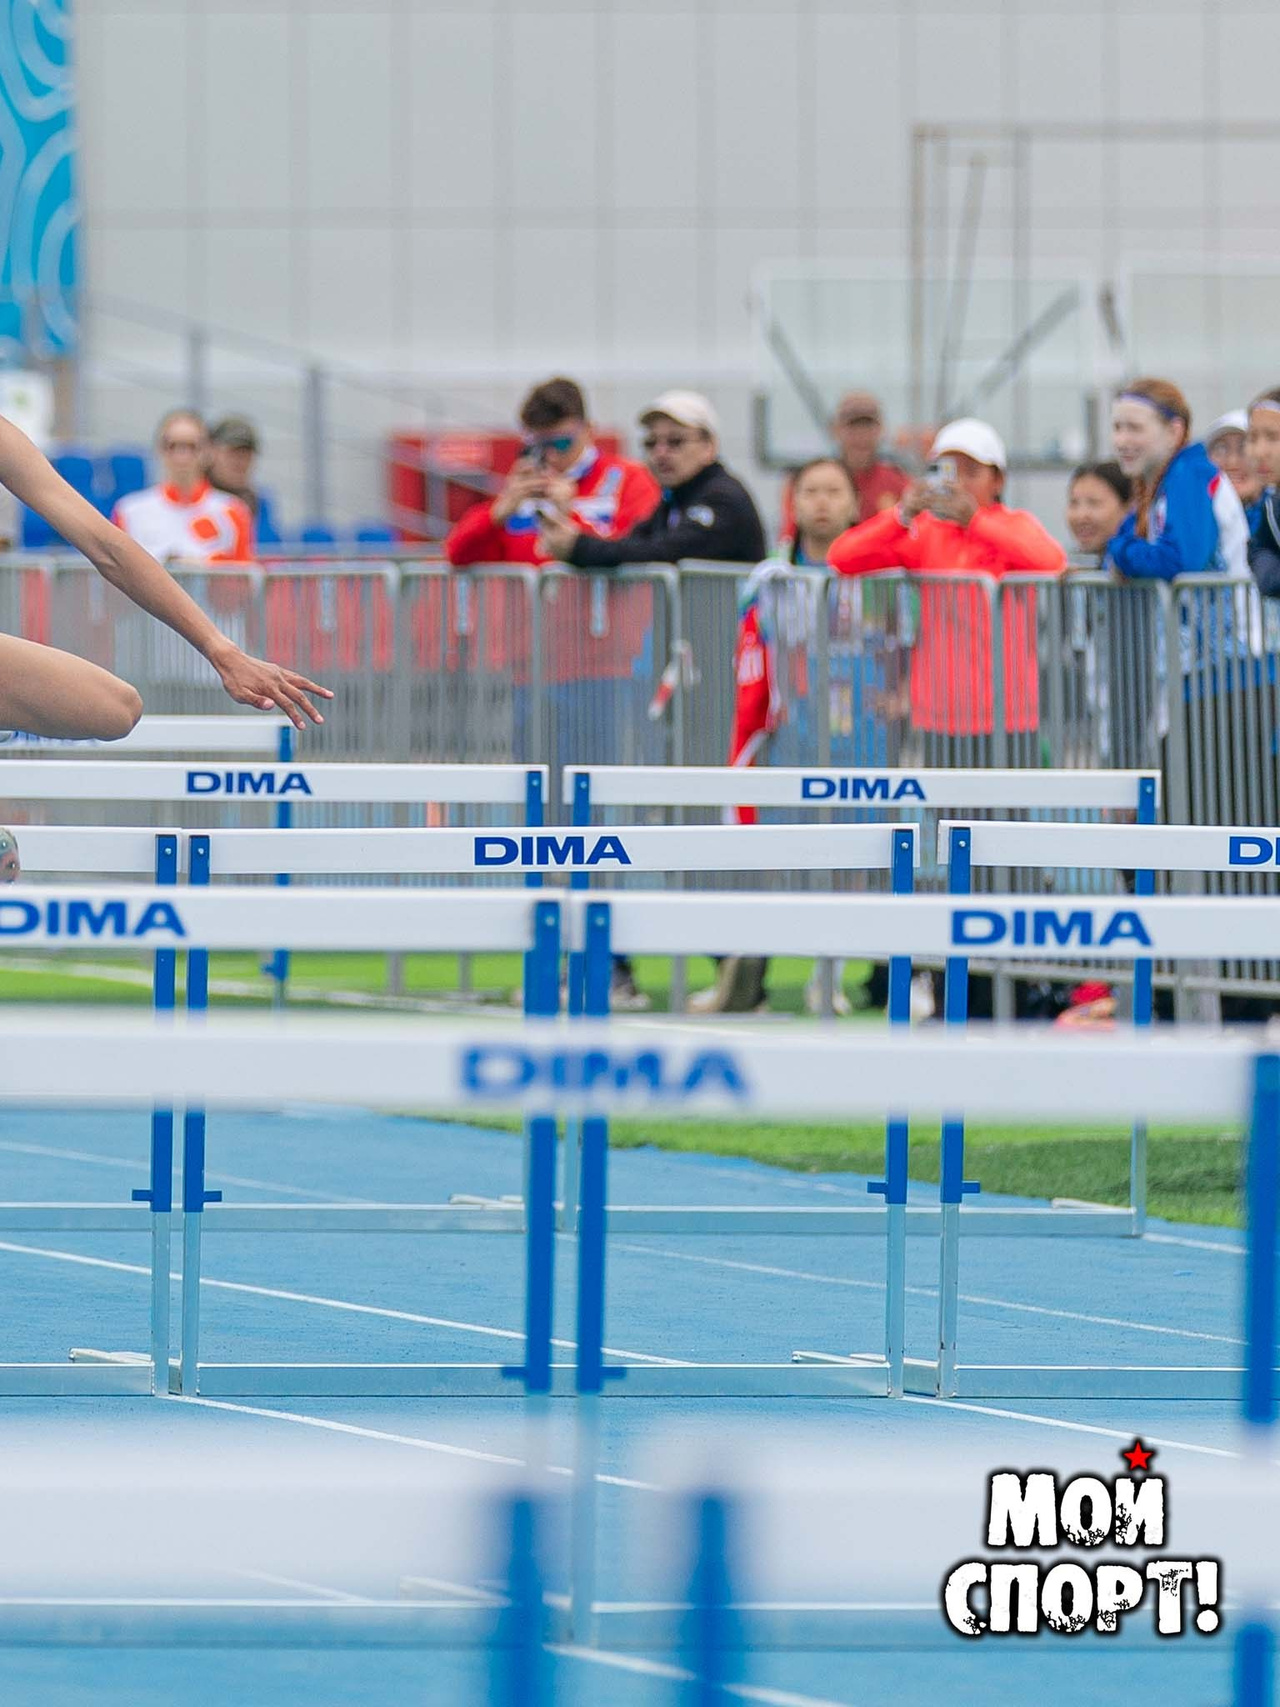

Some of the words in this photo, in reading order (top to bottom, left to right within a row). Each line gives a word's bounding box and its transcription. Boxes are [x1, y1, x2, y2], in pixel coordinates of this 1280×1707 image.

[186, 771, 312, 795] DIMA
[801, 777, 926, 801] DIMA
[474, 836, 631, 865] DIMA
[950, 910, 1153, 947] DIMA
[458, 1044, 752, 1101] DIMA
